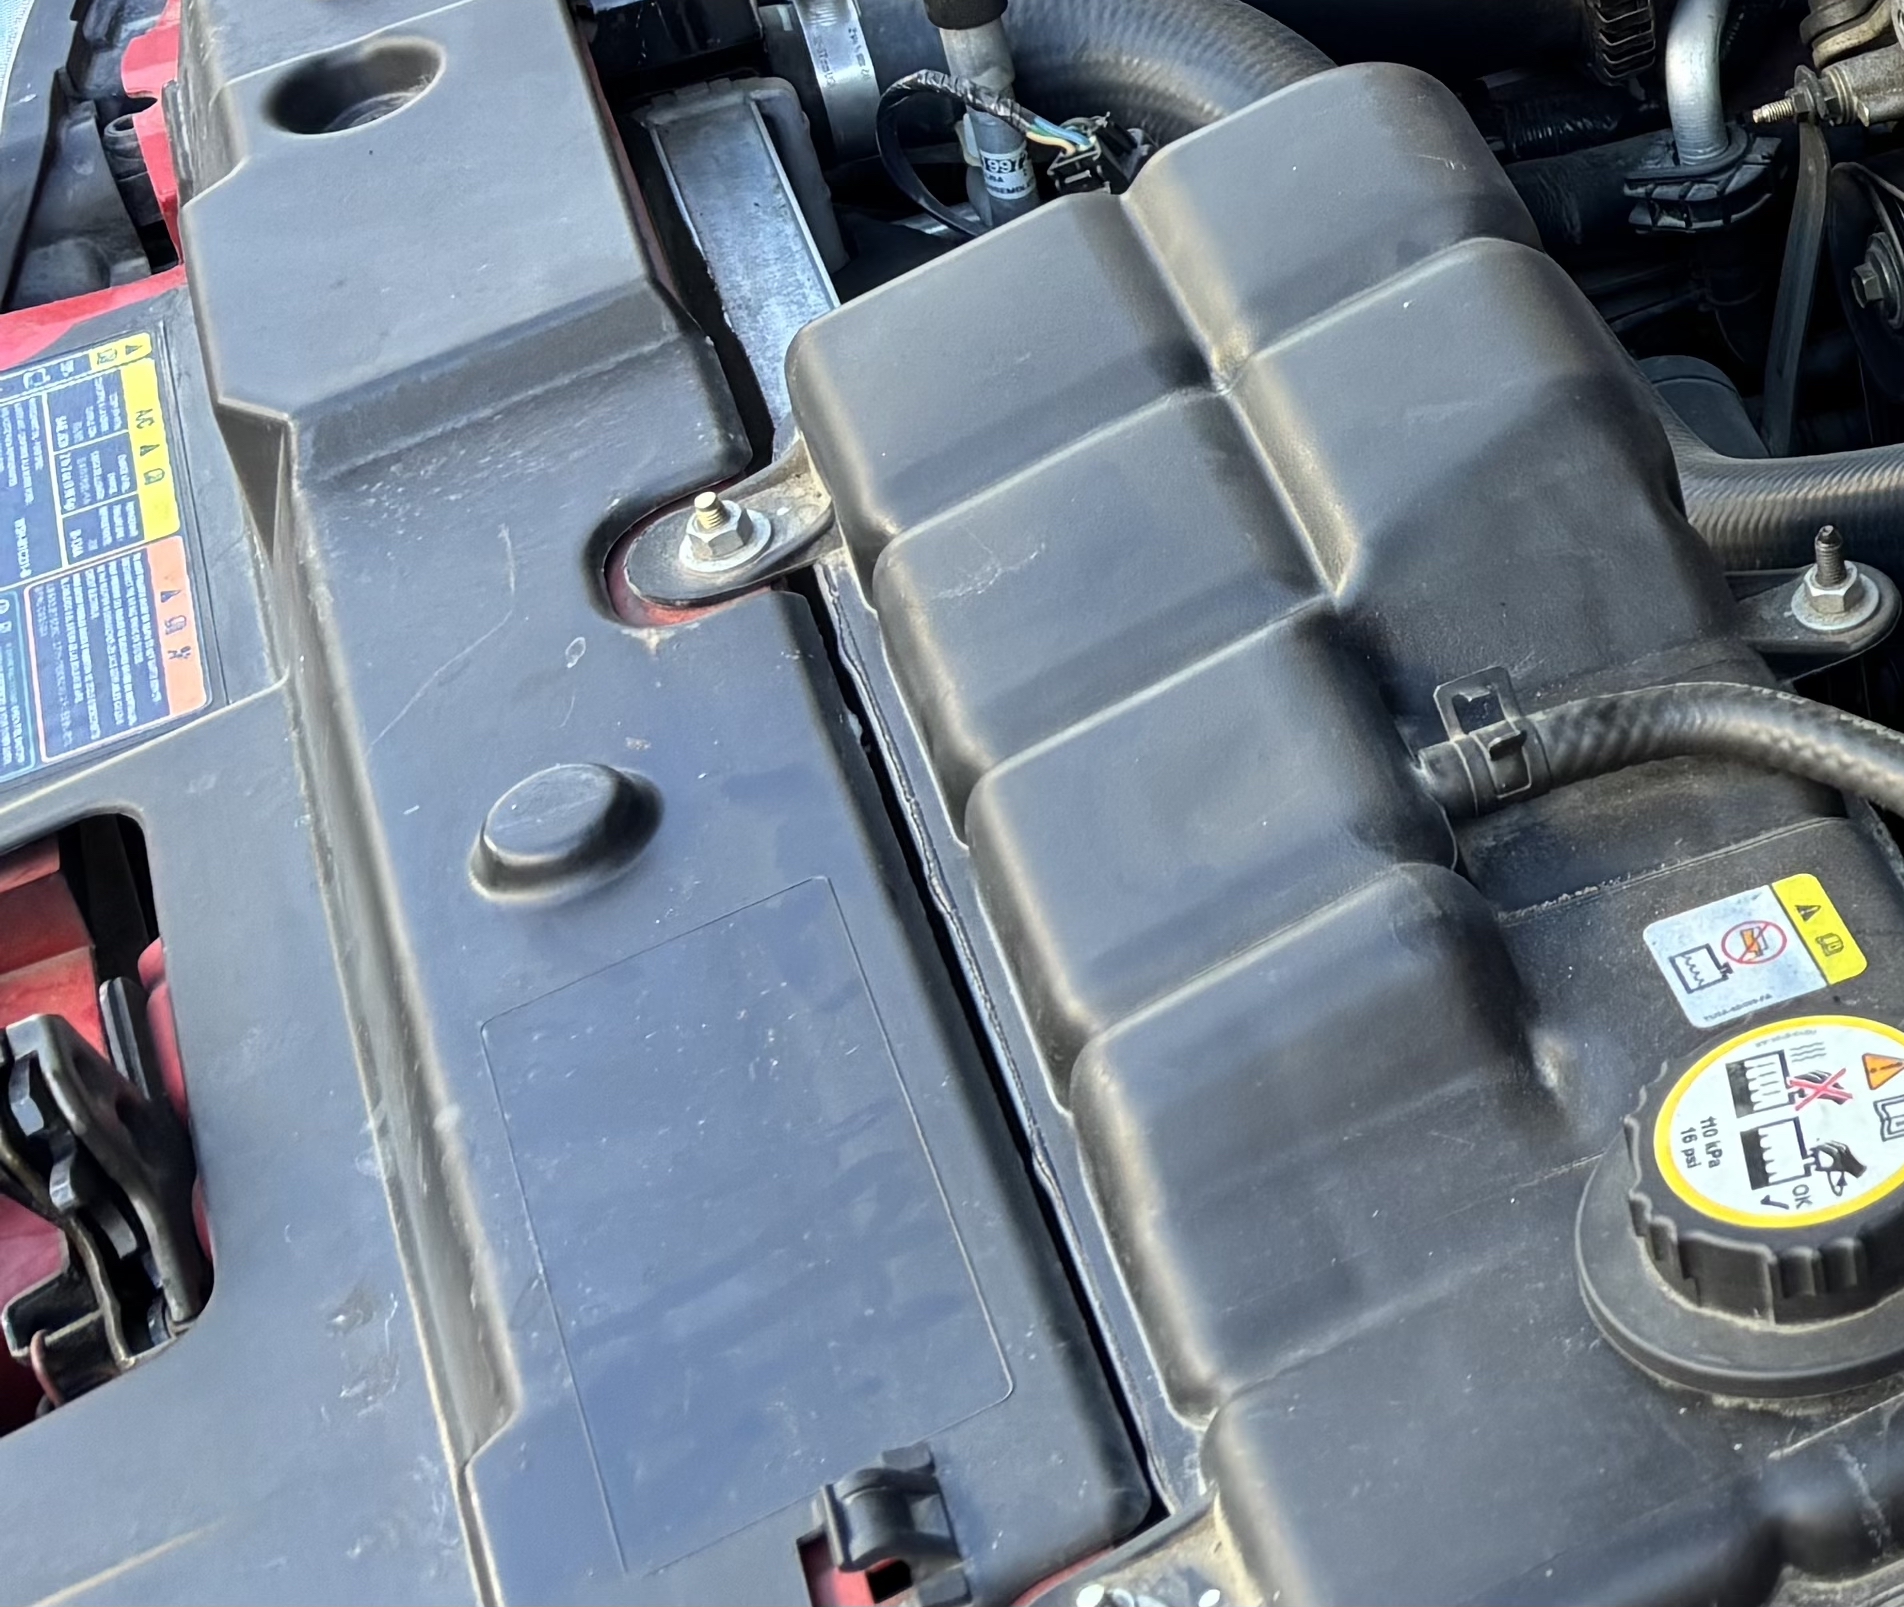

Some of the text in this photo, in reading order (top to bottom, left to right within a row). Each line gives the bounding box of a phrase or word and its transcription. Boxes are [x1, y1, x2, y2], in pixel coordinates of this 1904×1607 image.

[133, 407, 155, 430] A/C
[1680, 1129, 1701, 1169] 16 psi
[1700, 1115, 1723, 1169] 110 kPa
[1792, 1183, 1813, 1210] OK
